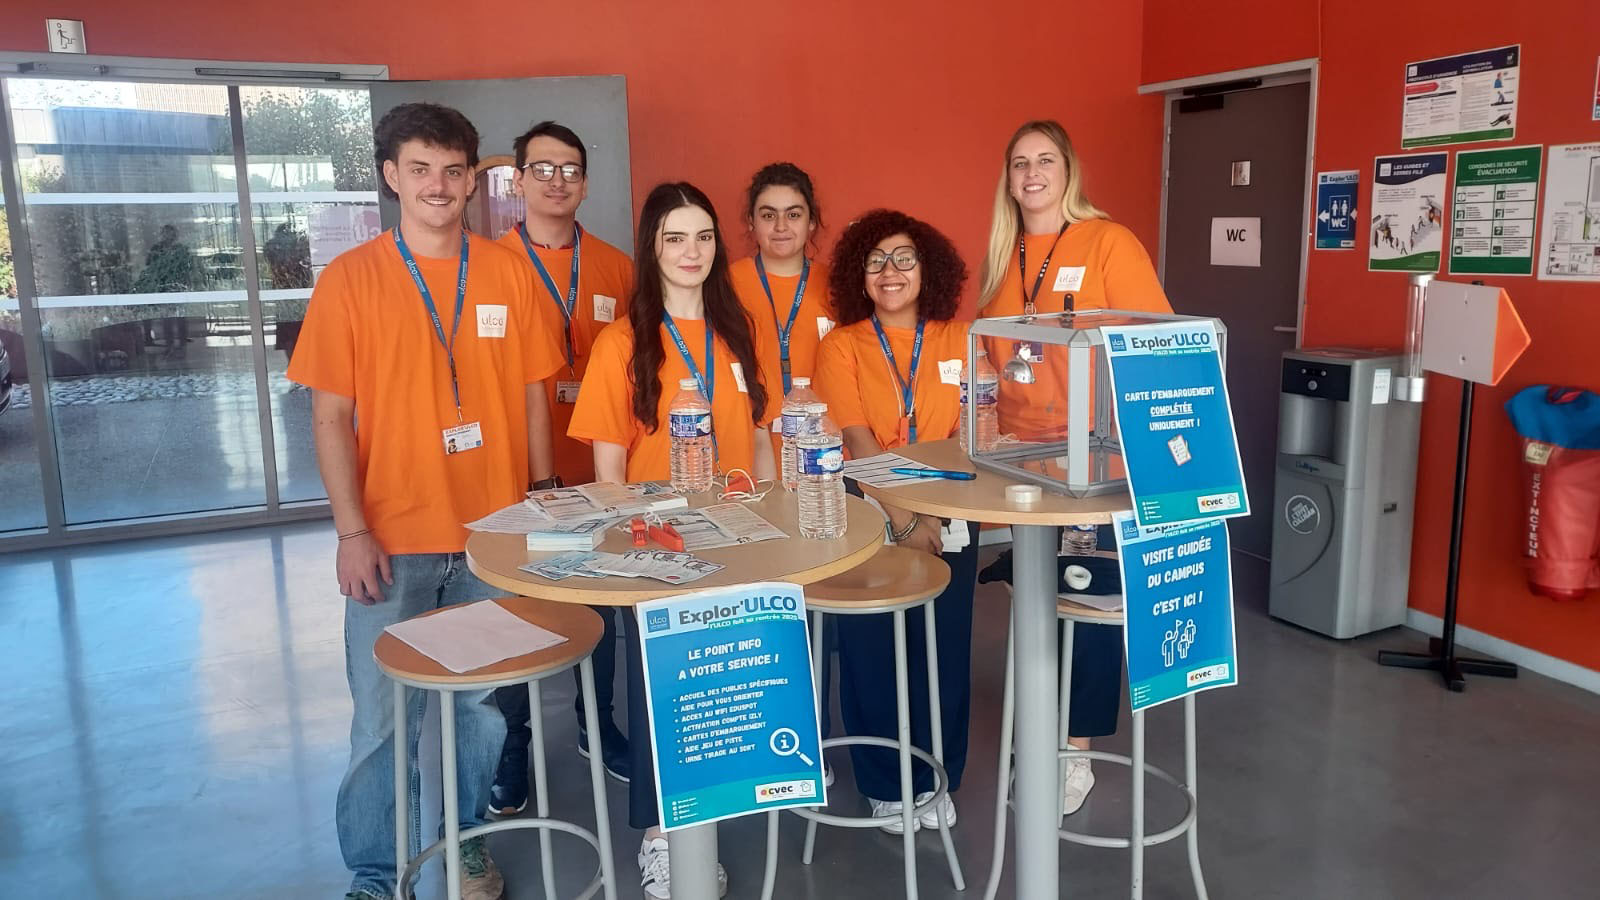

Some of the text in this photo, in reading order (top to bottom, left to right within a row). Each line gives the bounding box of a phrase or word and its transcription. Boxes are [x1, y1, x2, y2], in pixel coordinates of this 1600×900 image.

[1332, 218, 1346, 228] WC
[1226, 229, 1246, 242] WC
[482, 312, 504, 326] ulco
[1132, 332, 1210, 351] Explor'ULCO
[1125, 386, 1214, 402] CARTE D'EMBARQUEMENT
[1150, 402, 1193, 416] COMPLÉTÉE
[1149, 420, 1194, 432] UNIQUEMENT
[1206, 498, 1223, 506] cvec
[1529, 474, 1541, 558] EXTINCTEUR
[1142, 536, 1212, 566] VISITE GUIDÉE
[1148, 562, 1205, 588] DU CAMPUS
[679, 596, 796, 624] Explor'ULCO
[1153, 591, 1203, 616] C'EST ICI !
[650, 616, 667, 624] ulco
[688, 638, 761, 661] LE POINT INFO
[678, 653, 779, 680] A VOTRE SERVICE !
[1195, 671, 1212, 679] cvec
[680, 678, 788, 702] ACCUEIL DES PUBLICS SPÉCIFIQUES
[681, 691, 764, 712] AIDE POUR VOUS ORIENTER
[682, 713, 702, 722] ACCES
[715, 707, 728, 716] WIFI
[730, 702, 757, 713] EDUSPOT
[682, 720, 720, 733] ACTIVATION
[722, 714, 747, 725] COMPTE
[683, 722, 766, 743] CARTES D'EMBARQUEMENT
[685, 745, 698, 753] AIDE
[701, 742, 713, 750] JEU
[725, 736, 743, 746] PISTE
[686, 754, 702, 764] URNE
[705, 750, 726, 760] TIRAGE
[740, 744, 756, 753] SORT
[768, 785, 793, 795] cvec
